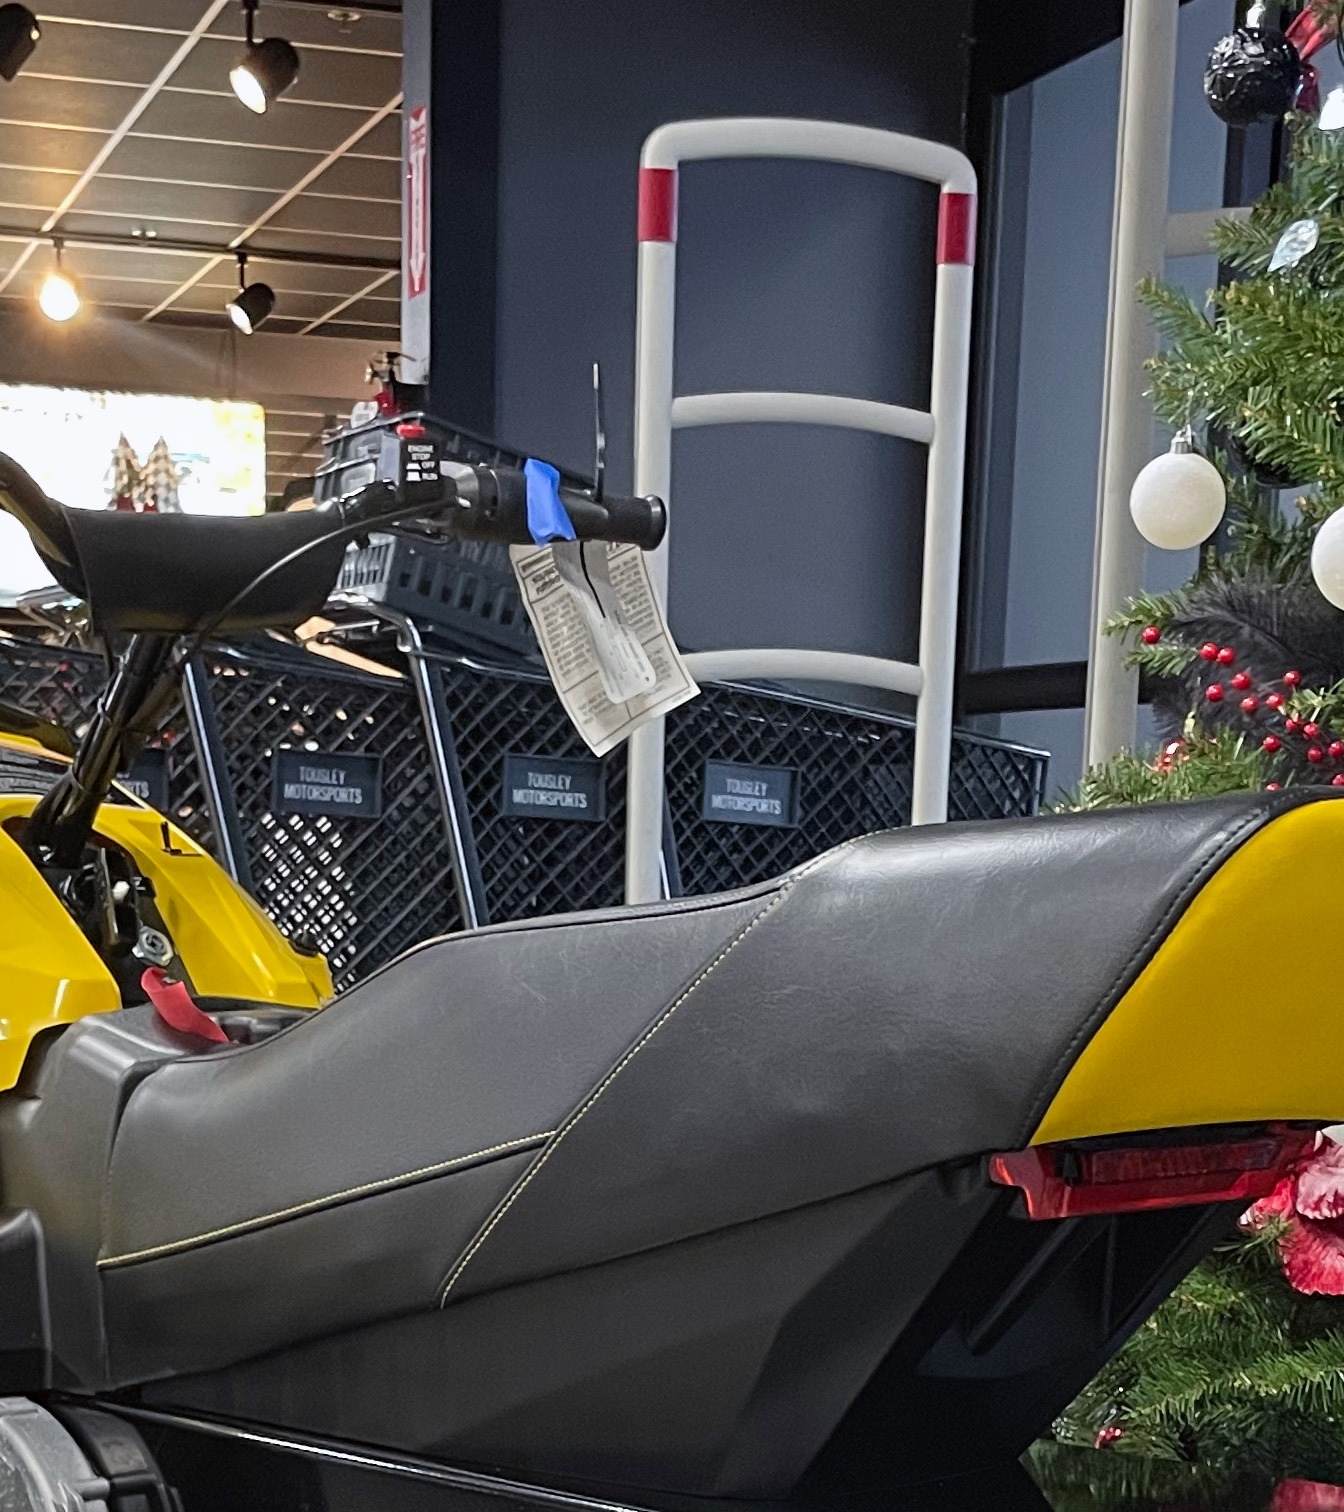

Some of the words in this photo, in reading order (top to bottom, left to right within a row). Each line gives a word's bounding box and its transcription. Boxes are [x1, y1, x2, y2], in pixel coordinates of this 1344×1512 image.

[299, 766, 347, 785] TOUSLEY
[527, 772, 572, 790] TOUSLEY
[283, 783, 363, 804] MOTORSPORTS
[725, 778, 768, 796] TOUSLEY
[512, 788, 588, 808] MOTORSPORTS
[711, 795, 782, 815] MOTORSPORTS
